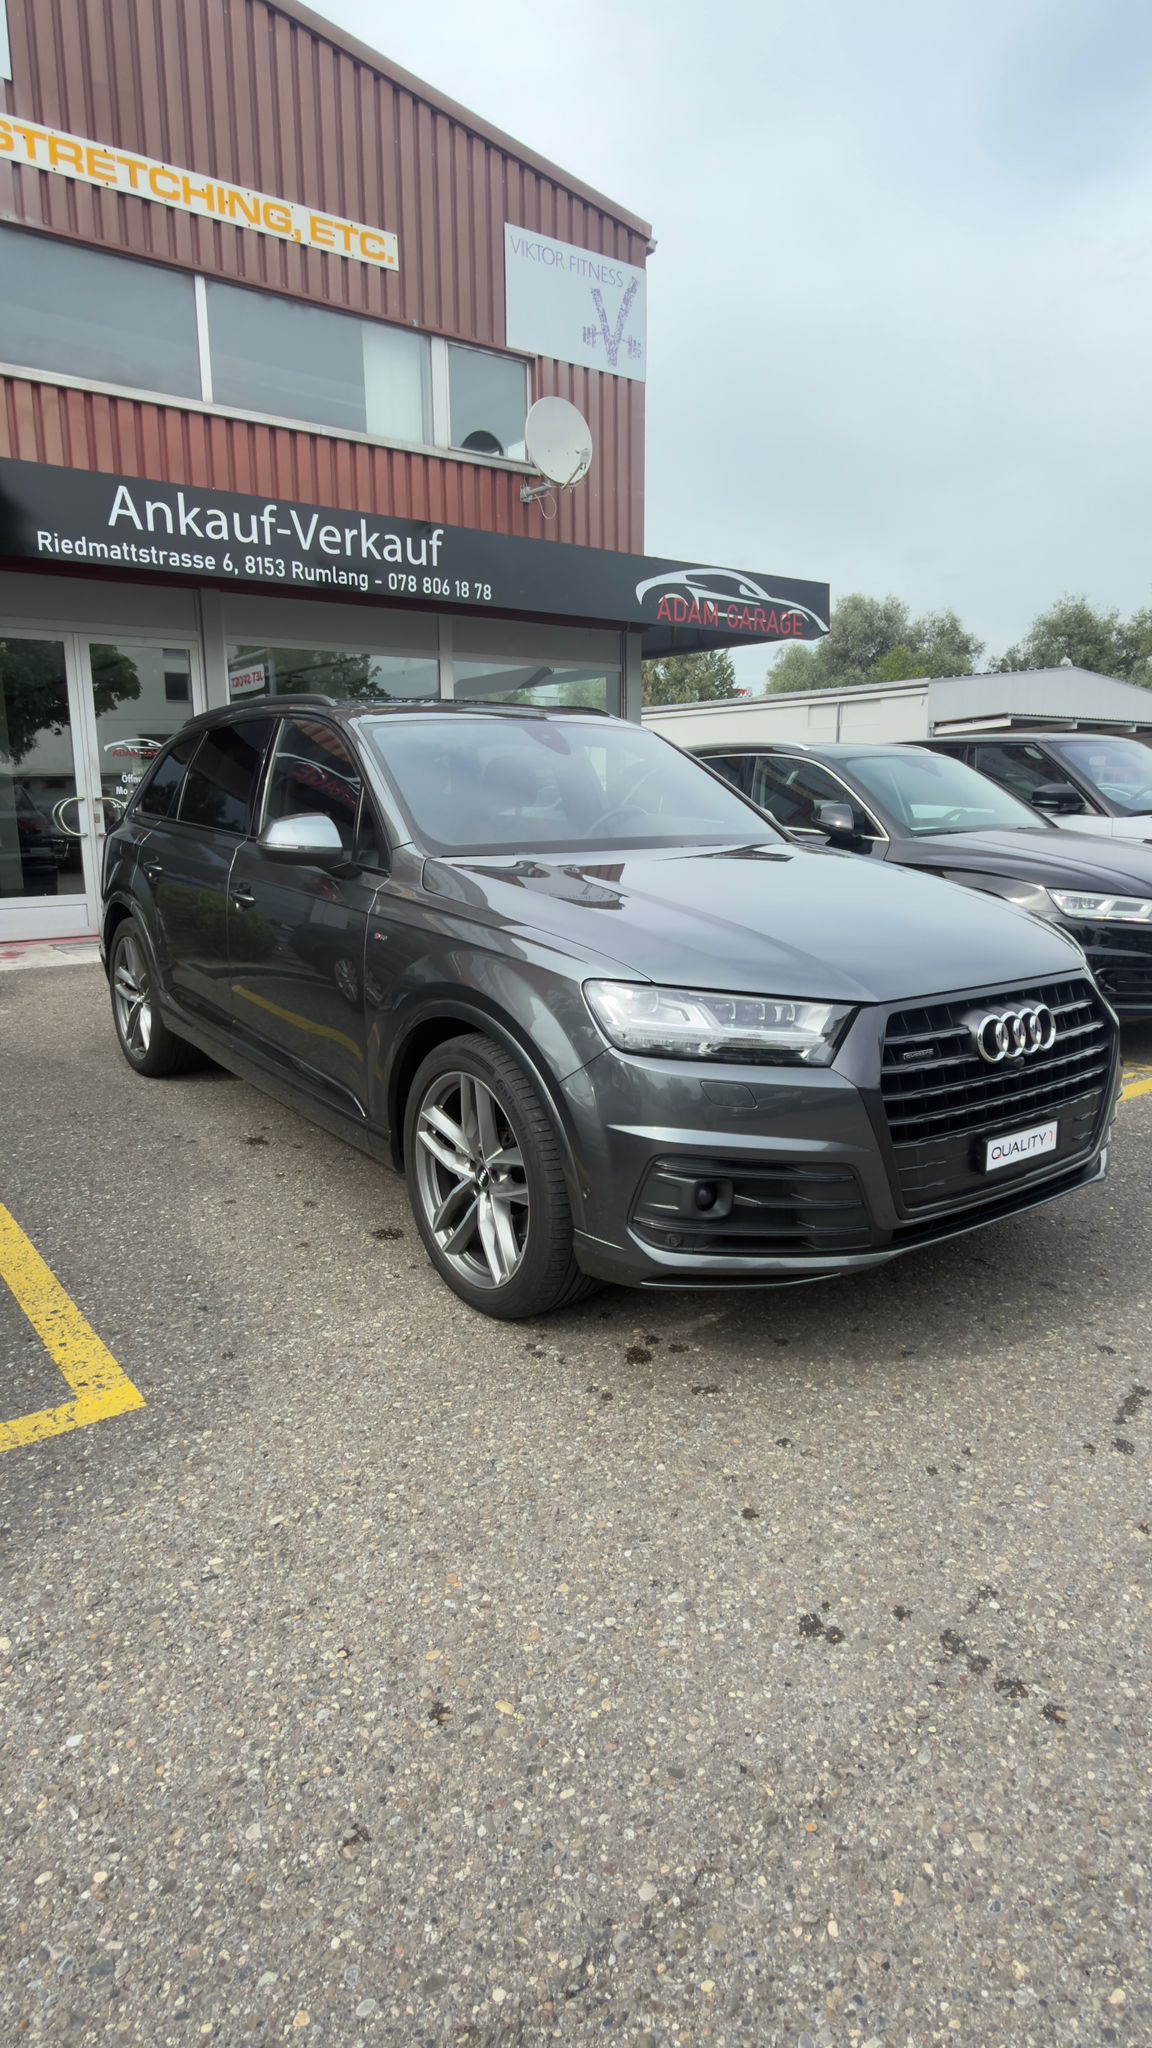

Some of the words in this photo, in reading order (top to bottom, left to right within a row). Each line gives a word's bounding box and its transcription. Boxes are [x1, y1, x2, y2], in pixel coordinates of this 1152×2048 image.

[310, 217, 394, 264] ETC.
[510, 235, 565, 270] VIKTOR
[570, 256, 624, 288] FITNESS
[108, 485, 444, 566] Ankauf-Verkauf
[37, 530, 216, 570] Riedmattstrasse
[223, 553, 238, 575] 6,
[245, 556, 285, 578] 8153
[292, 561, 368, 591] Rumlang
[388, 573, 417, 592] 078
[423, 577, 450, 596] 806
[455, 580, 469, 598] 18
[475, 583, 492, 600] 78
[657, 596, 719, 628] ADAM
[727, 604, 804, 636] GARAGE
